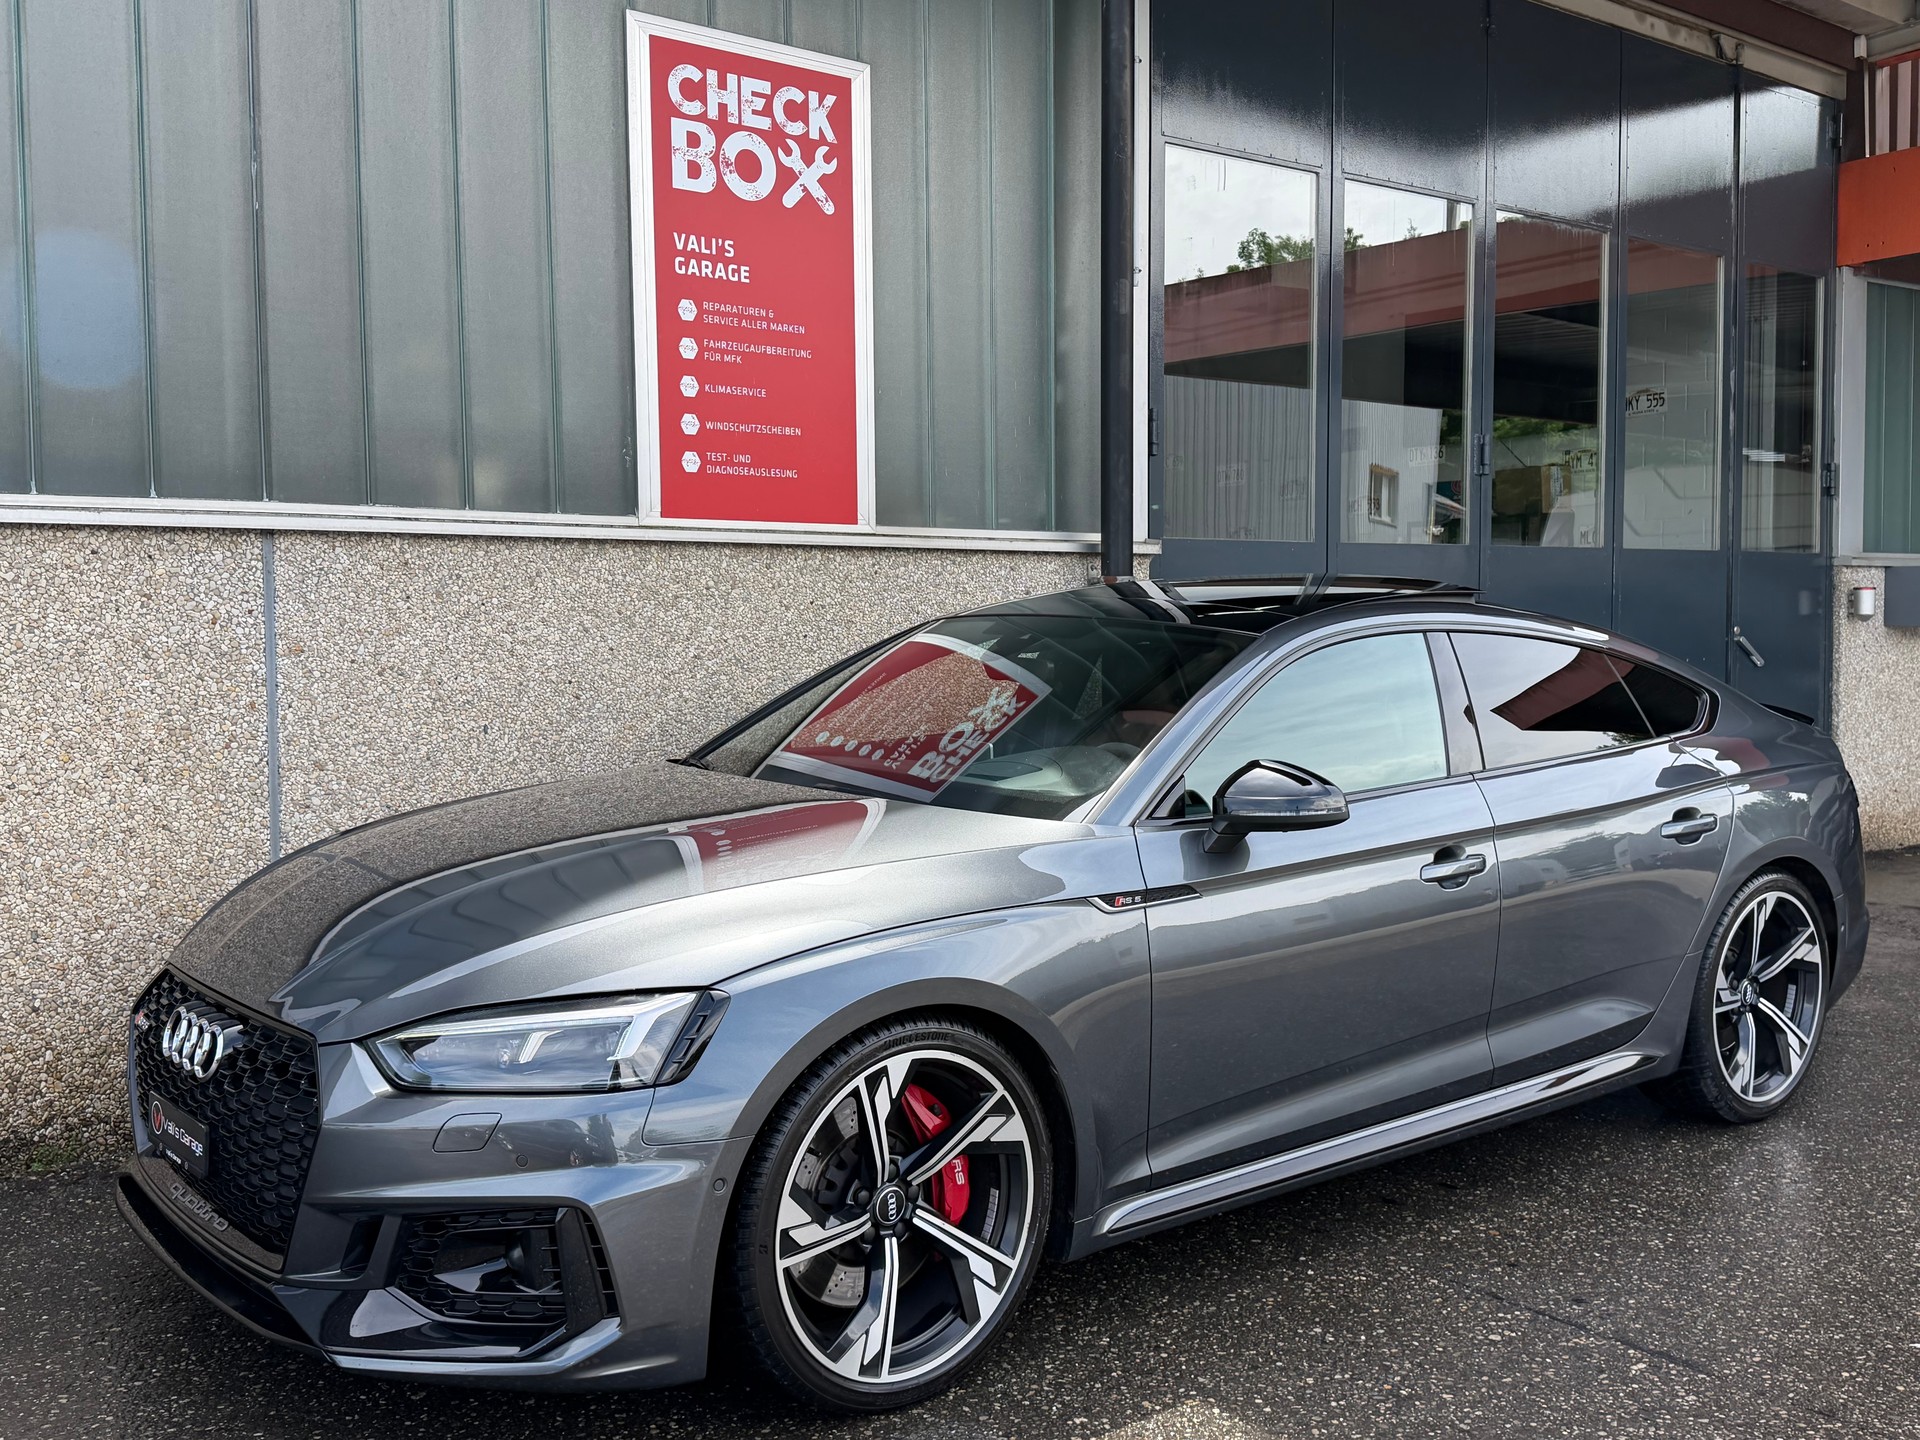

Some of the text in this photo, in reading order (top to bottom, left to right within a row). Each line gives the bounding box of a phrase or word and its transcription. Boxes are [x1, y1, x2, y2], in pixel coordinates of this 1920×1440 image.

[667, 63, 838, 144] CHECK
[670, 117, 838, 215] BOX
[673, 232, 735, 257] VALI'S
[674, 257, 750, 283] GARAGE
[703, 301, 775, 318] REPARATUREN &
[703, 314, 806, 334] SERVICE ALLER MARKEN
[703, 339, 812, 359] FAHRZEUGAUFBEREITUNG
[704, 351, 742, 364] FÜR MFK
[704, 383, 767, 398] KLIMASERVICE
[1646, 391, 1666, 409] 555
[705, 421, 802, 436] WINDSCHUTZSCHEIBEN
[706, 452, 751, 463] TEST- UND
[706, 464, 798, 478] DIAGNOSEAUSLESUNG
[952, 1159, 965, 1185] RS
[170, 1182, 229, 1231] quattro
